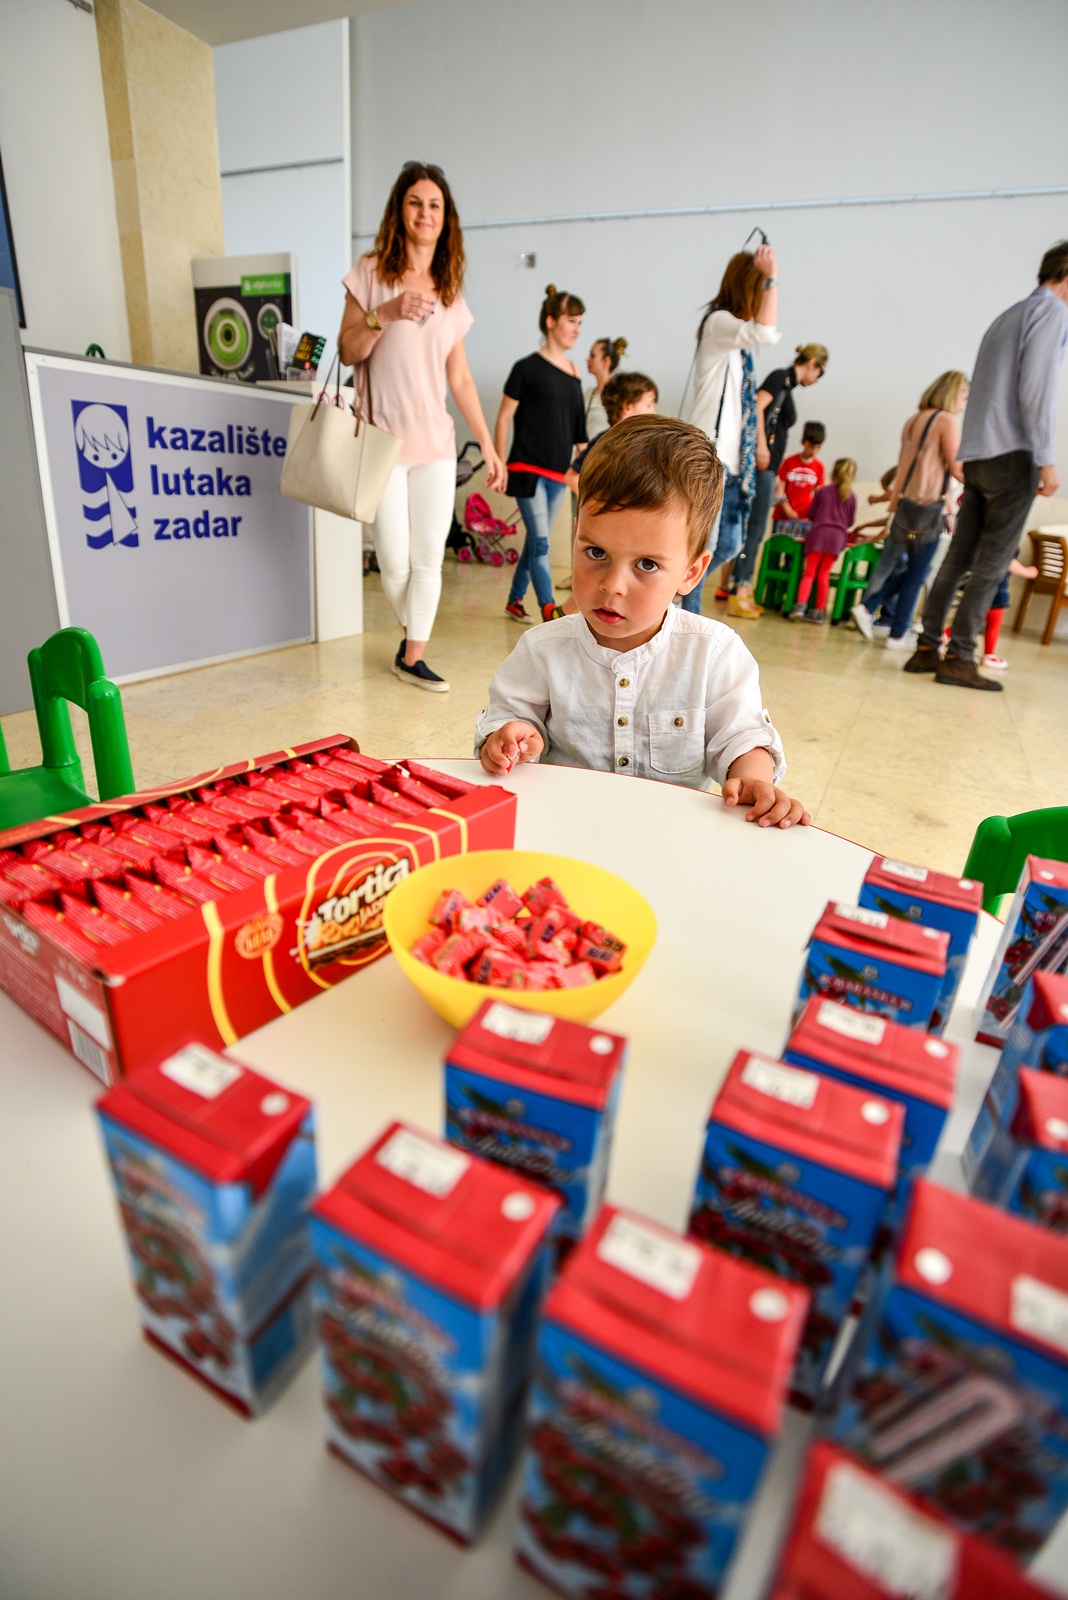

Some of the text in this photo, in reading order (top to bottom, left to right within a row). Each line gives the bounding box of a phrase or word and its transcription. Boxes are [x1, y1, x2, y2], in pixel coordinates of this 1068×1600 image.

[146, 416, 287, 457] kazalište
[150, 464, 252, 497] lutaka
[153, 509, 243, 541] zadar
[317, 857, 410, 924] Tortica
